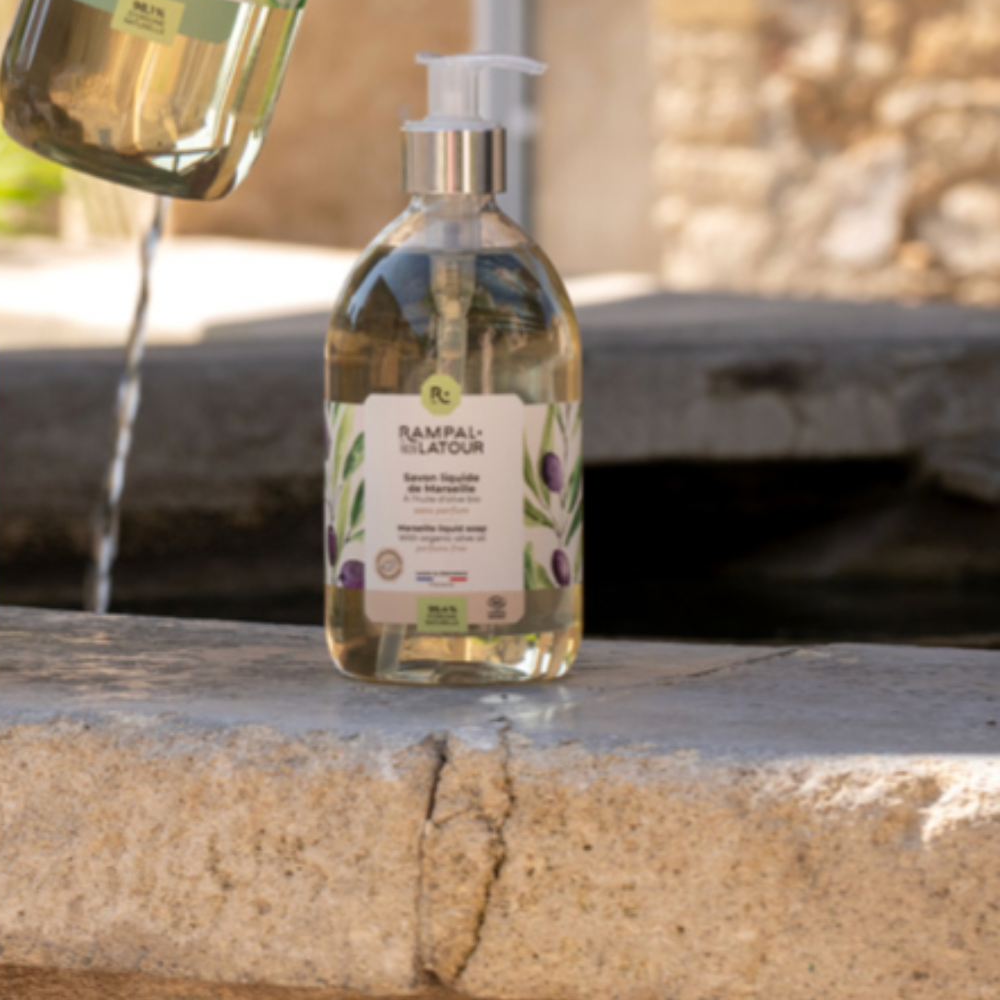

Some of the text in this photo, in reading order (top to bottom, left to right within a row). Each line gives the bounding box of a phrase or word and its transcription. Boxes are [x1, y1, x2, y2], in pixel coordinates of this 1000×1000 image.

[418, 440, 484, 455] LATOUR
[403, 471, 481, 485] Savon liquide
[407, 483, 476, 494] de Marseille
